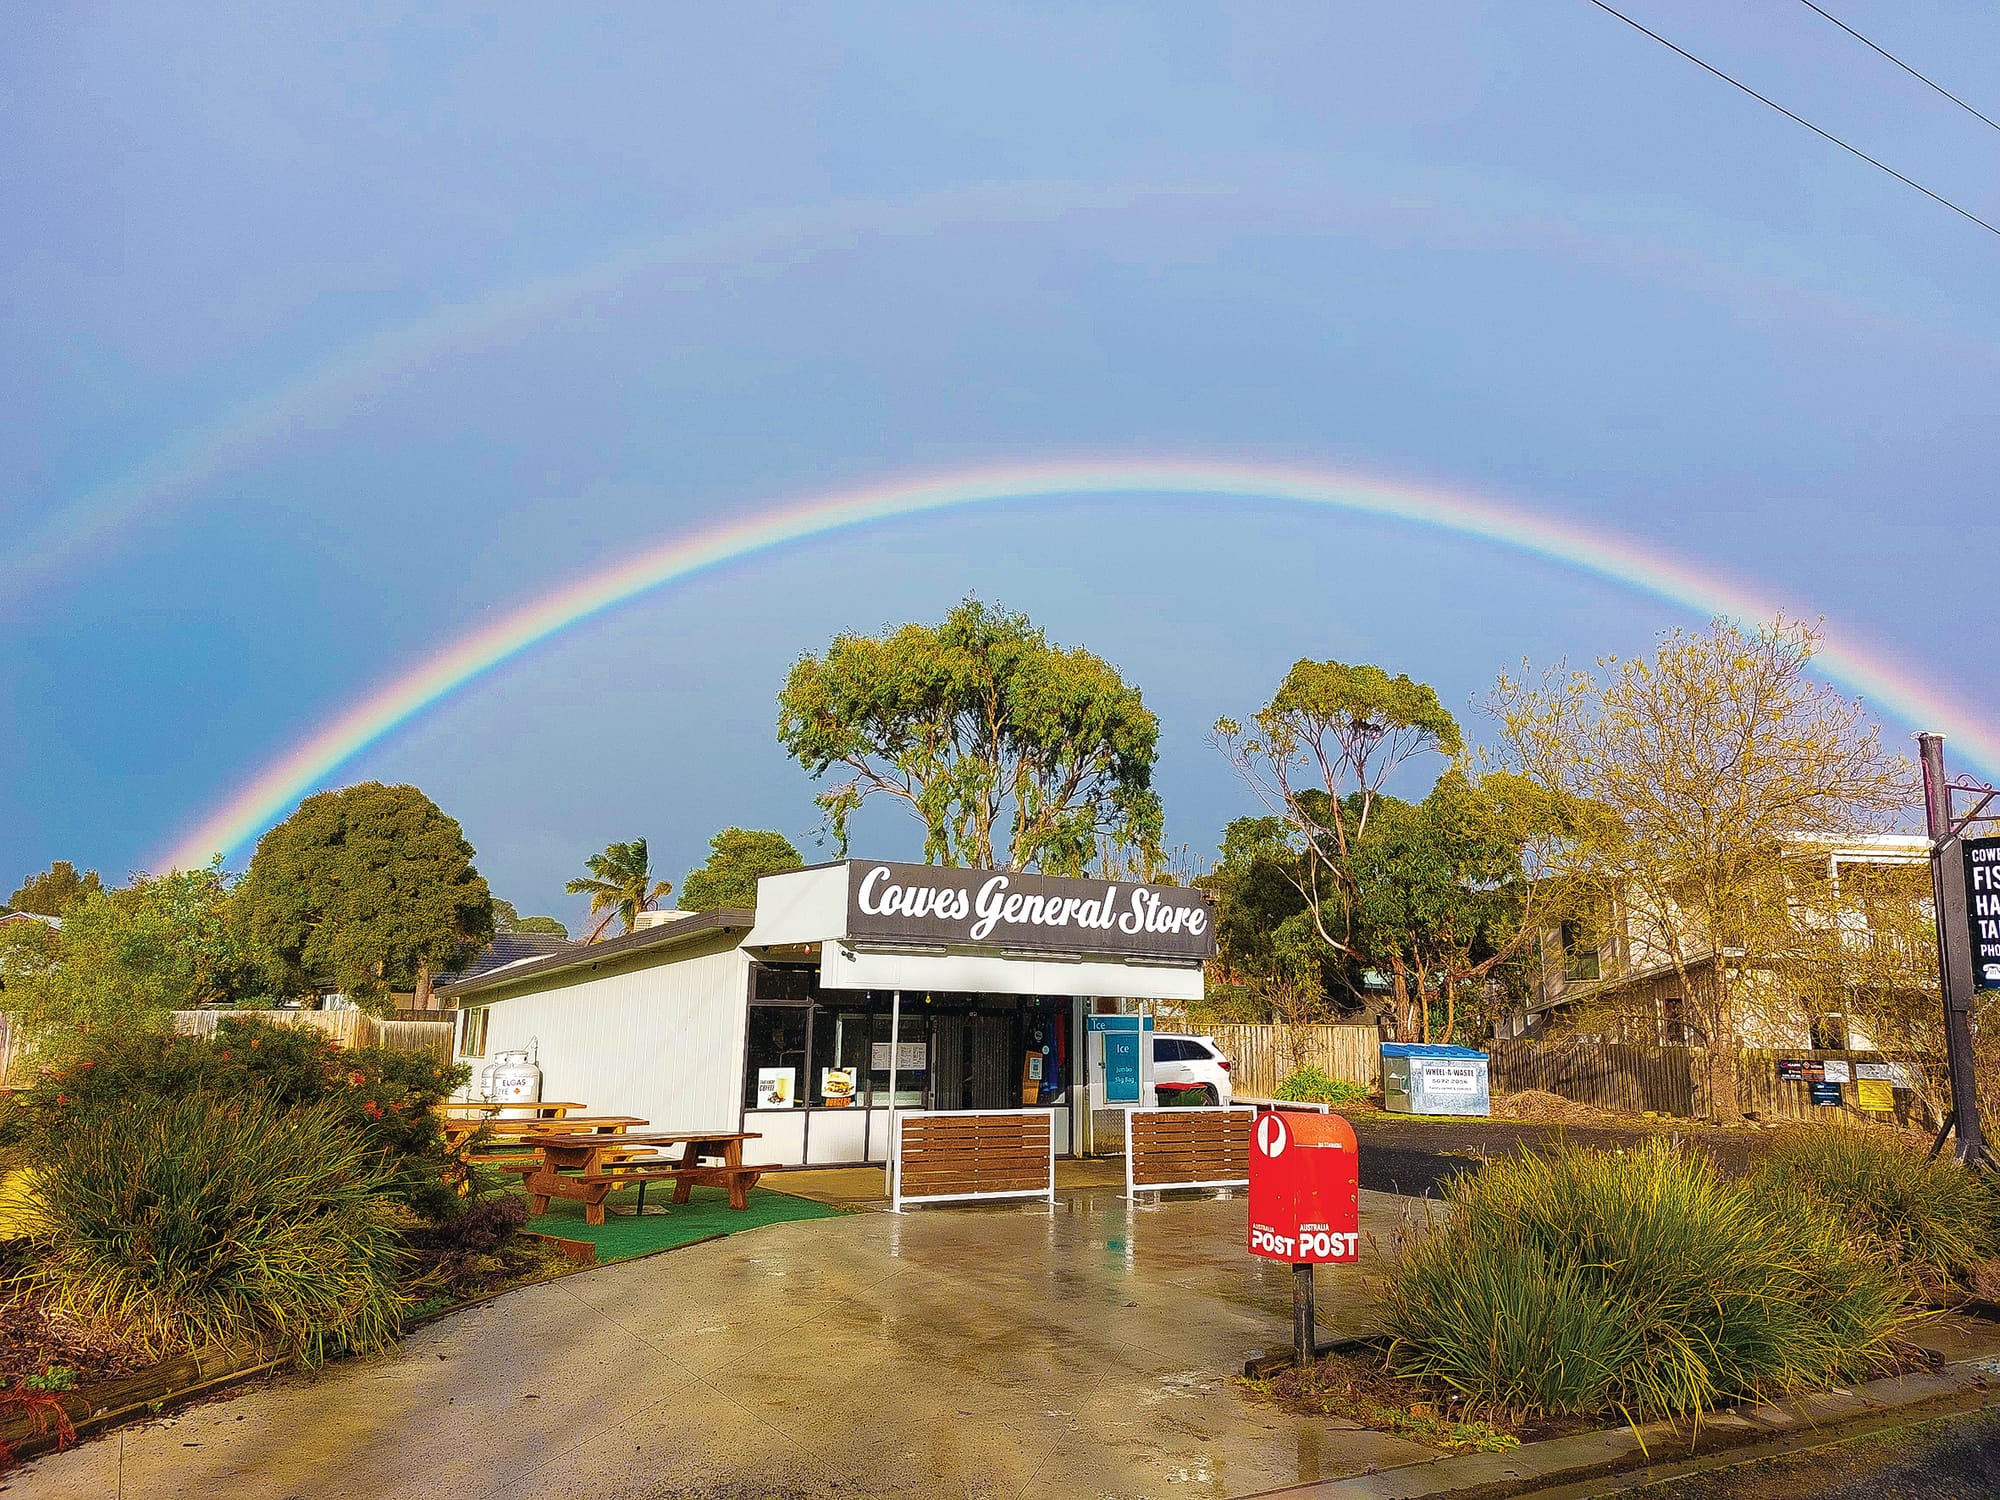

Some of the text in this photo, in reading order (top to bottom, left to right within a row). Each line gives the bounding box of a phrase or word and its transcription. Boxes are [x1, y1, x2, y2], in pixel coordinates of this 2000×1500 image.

[858, 866, 1207, 941] Cowes General Store
[1978, 919, 2000, 939] TA
[1093, 1020, 1106, 1030] Ice
[1116, 1044, 1130, 1053] Ice
[502, 1079, 526, 1087] ELGAS
[1253, 1223, 1275, 1233] AUSTRALIA
[1300, 1223, 1330, 1232] AUSTRALIA
[1252, 1230, 1295, 1257] POST
[1300, 1232, 1358, 1257] POST
